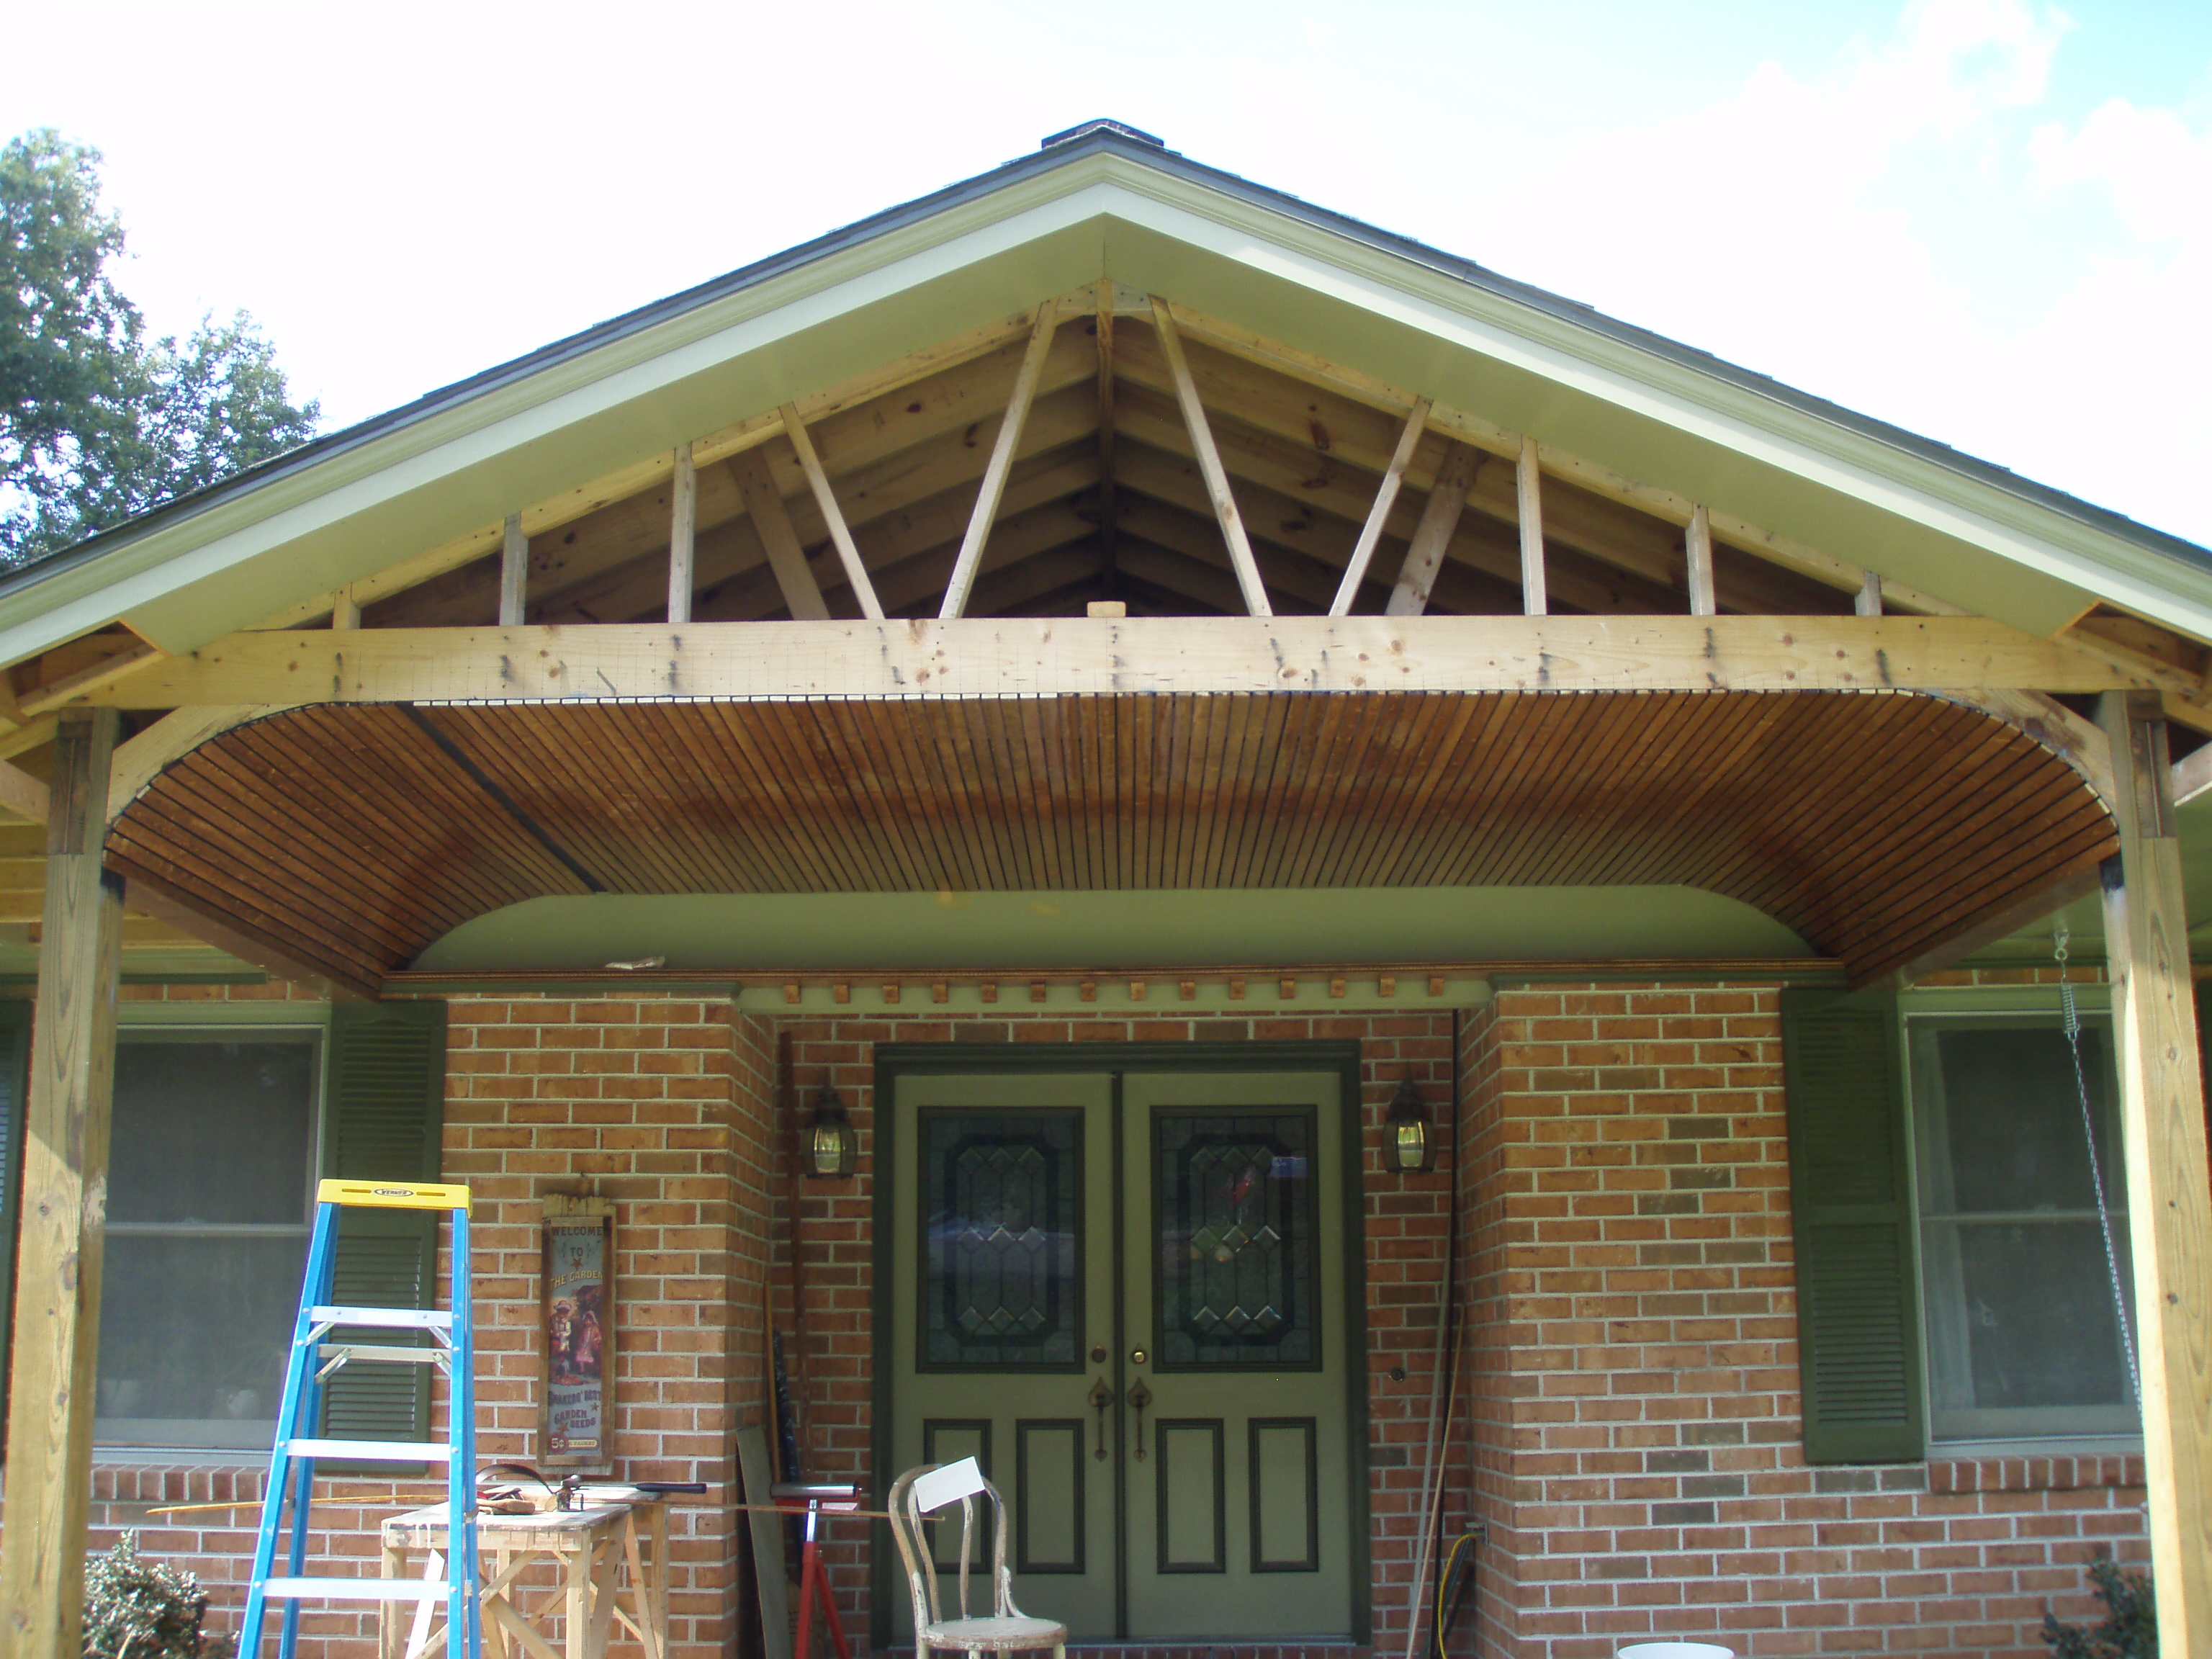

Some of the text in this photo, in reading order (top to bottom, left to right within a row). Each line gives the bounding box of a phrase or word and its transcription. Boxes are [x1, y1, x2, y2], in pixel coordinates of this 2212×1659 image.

[552, 1226, 603, 1236] WELCOME
[570, 1247, 583, 1256] TO
[550, 1270, 603, 1288] THE GARDEN
[554, 1409, 587, 1424] GARDEN
[570, 1416, 596, 1428] SEEDS
